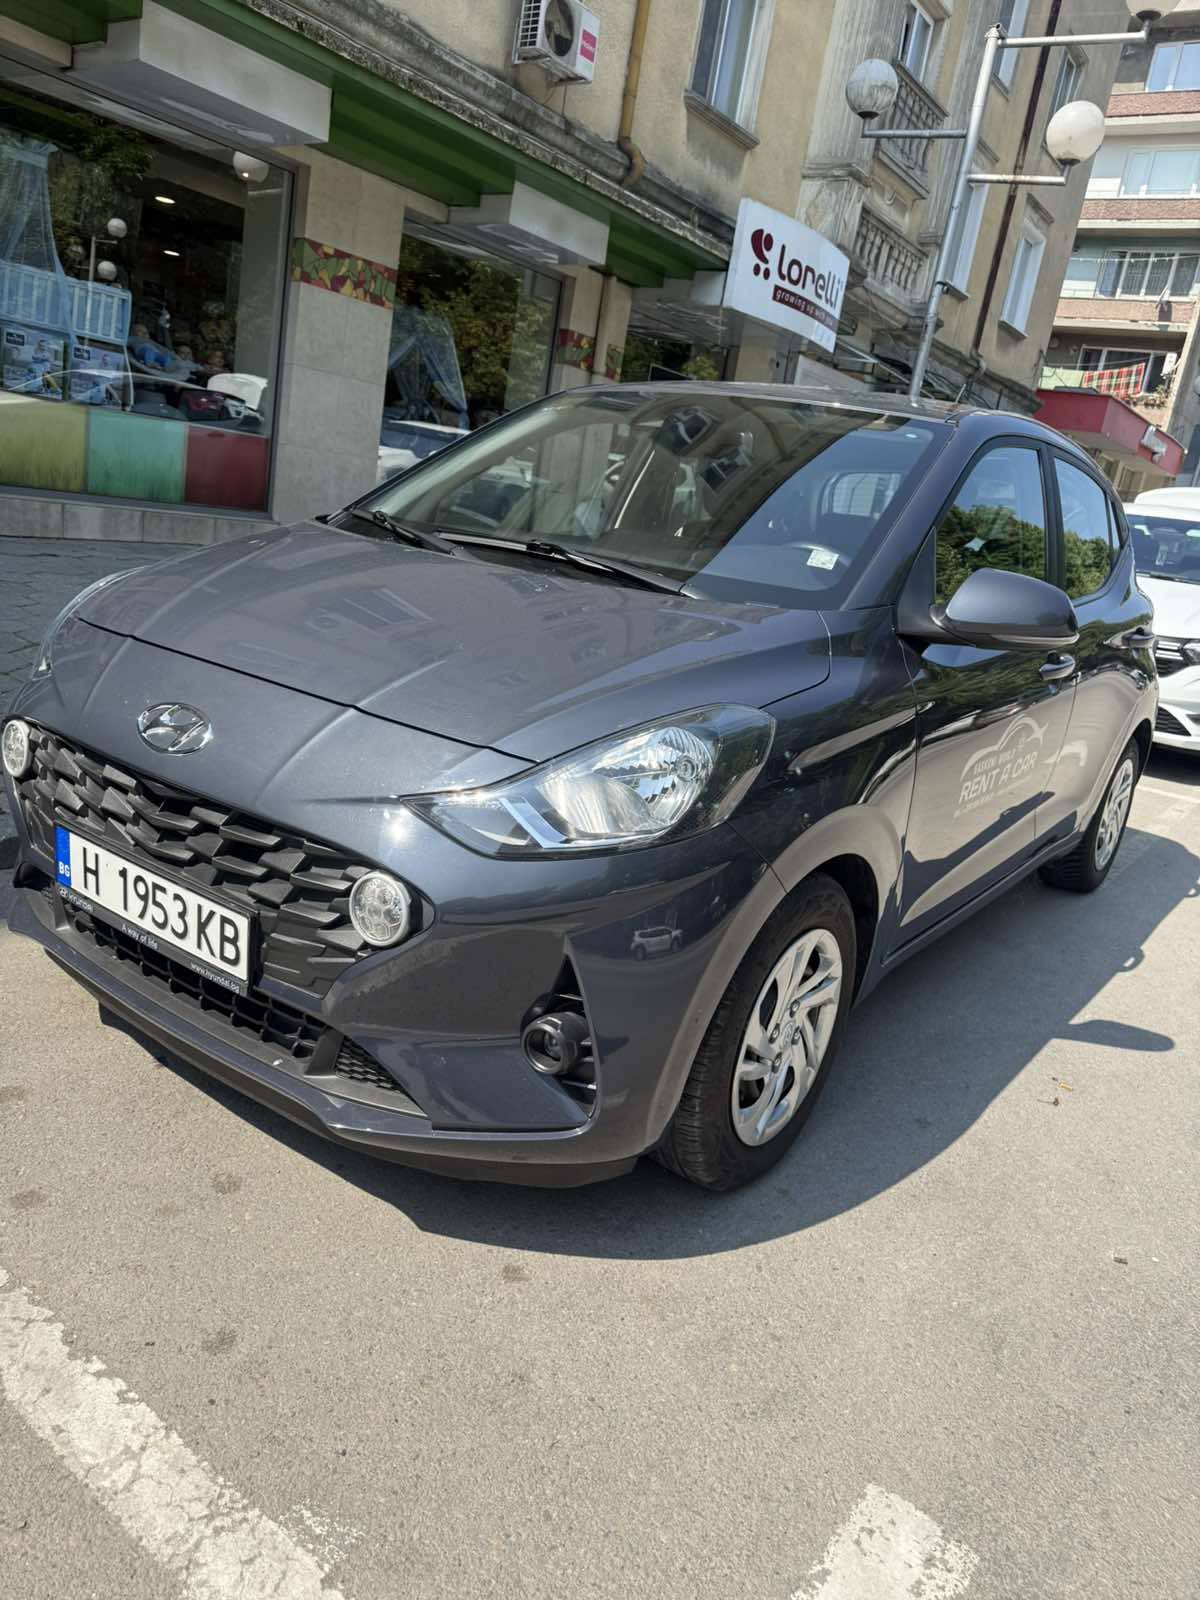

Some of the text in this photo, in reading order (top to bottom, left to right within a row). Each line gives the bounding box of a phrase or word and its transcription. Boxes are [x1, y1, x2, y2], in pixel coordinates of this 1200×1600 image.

[775, 289, 807, 312] growing
[958, 769, 1000, 804] RENT
[999, 763, 1011, 785] A
[1012, 751, 1038, 778] CAR
[58, 861, 71, 878] BG
[83, 846, 241, 967] H 1953 KB
